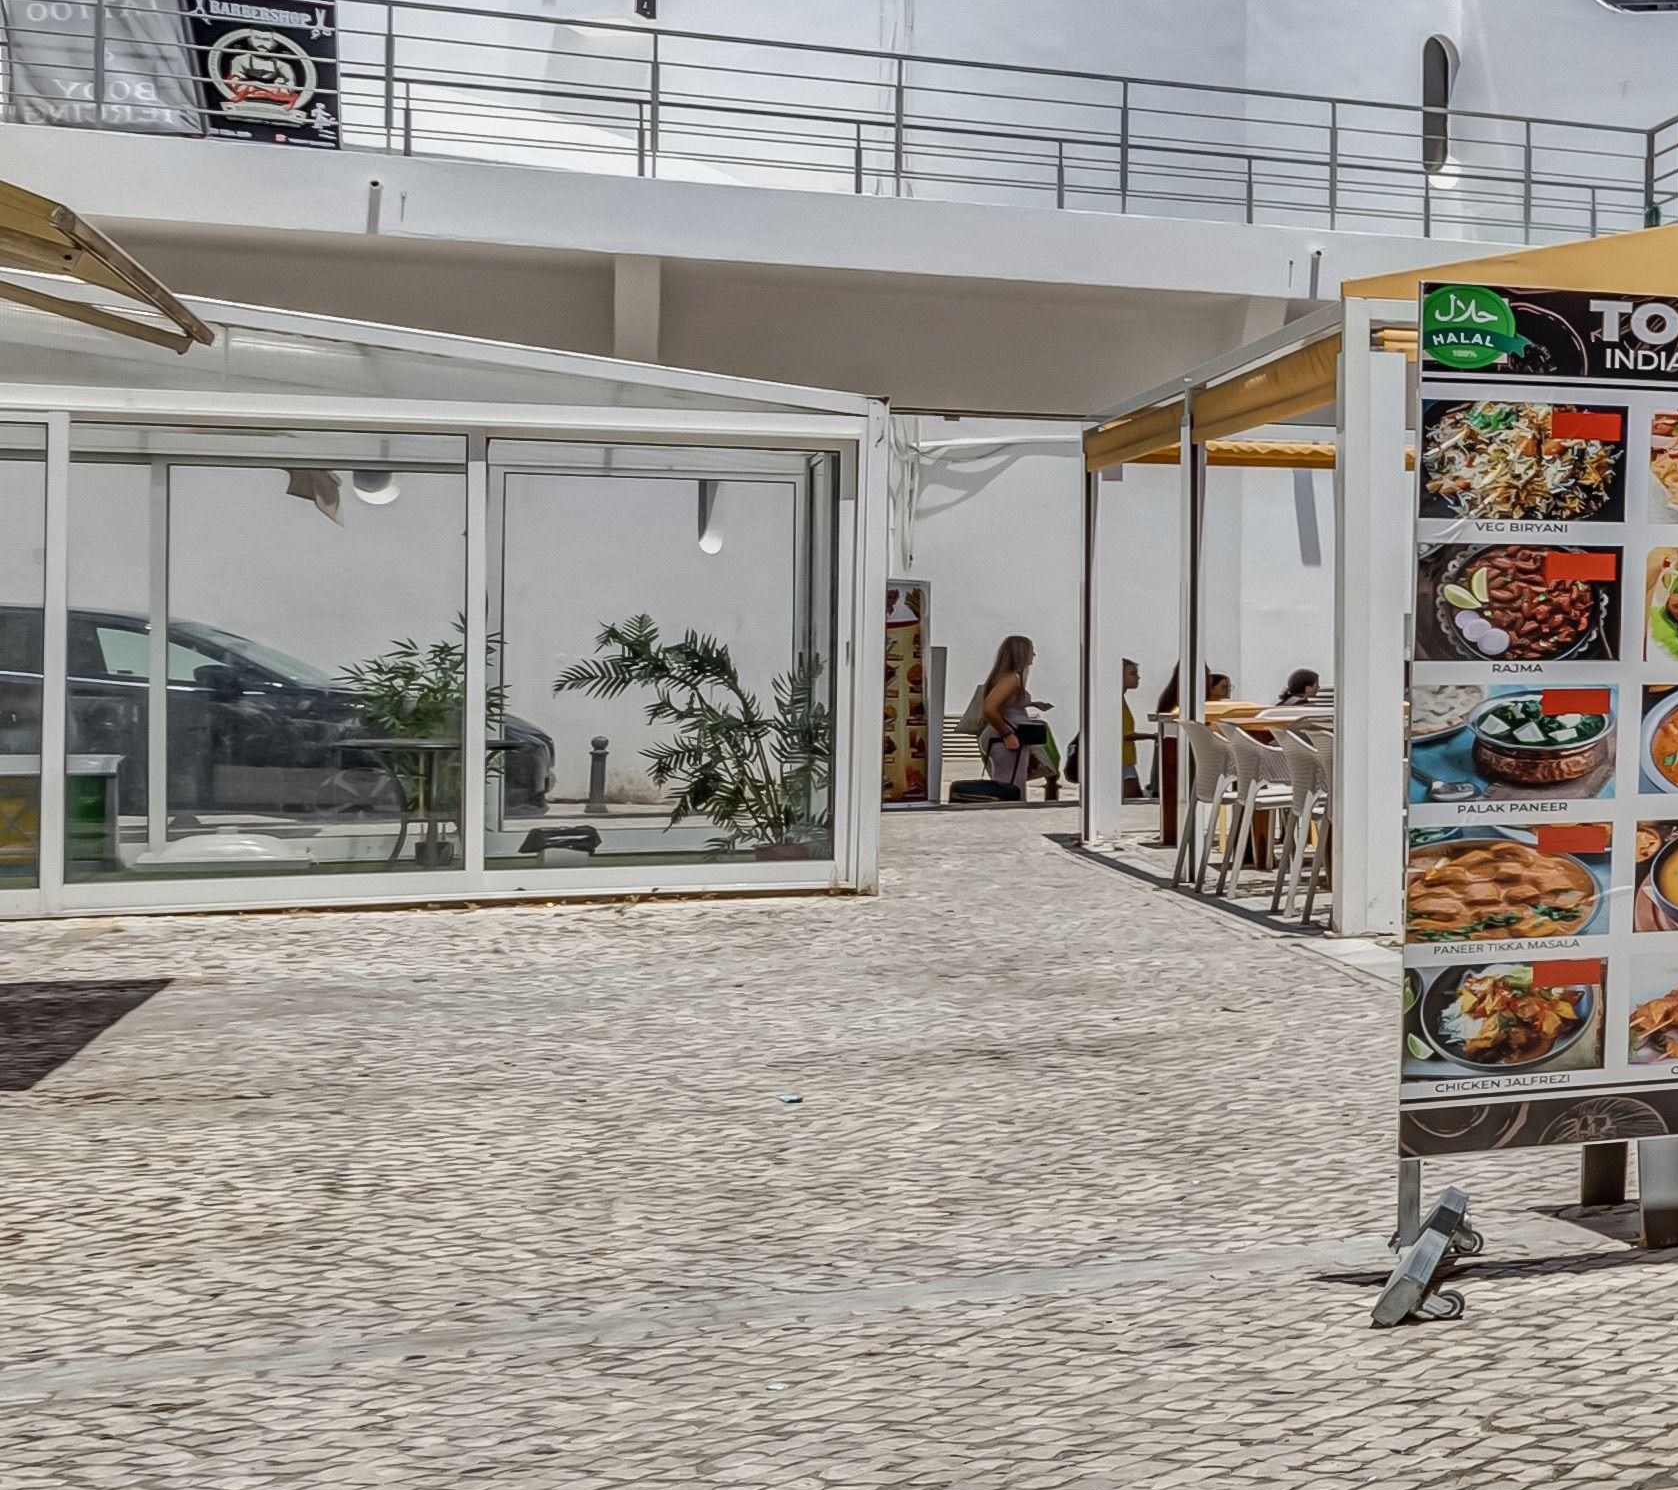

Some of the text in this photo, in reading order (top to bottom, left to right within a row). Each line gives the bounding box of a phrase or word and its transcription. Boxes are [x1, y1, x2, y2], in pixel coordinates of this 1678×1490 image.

[209, 0, 312, 26] BARBERSHOP
[1435, 294, 1498, 324] حلال
[1432, 333, 1494, 348] HALAL
[1475, 521, 1569, 534] VEG BIRYANI
[1491, 662, 1544, 674] RAJMA
[1457, 801, 1569, 814] PALAK PANEER
[1433, 939, 1580, 956] PANEER TIKKA MASALA
[1435, 1074, 1571, 1093] CHICKEN JALFREZI
